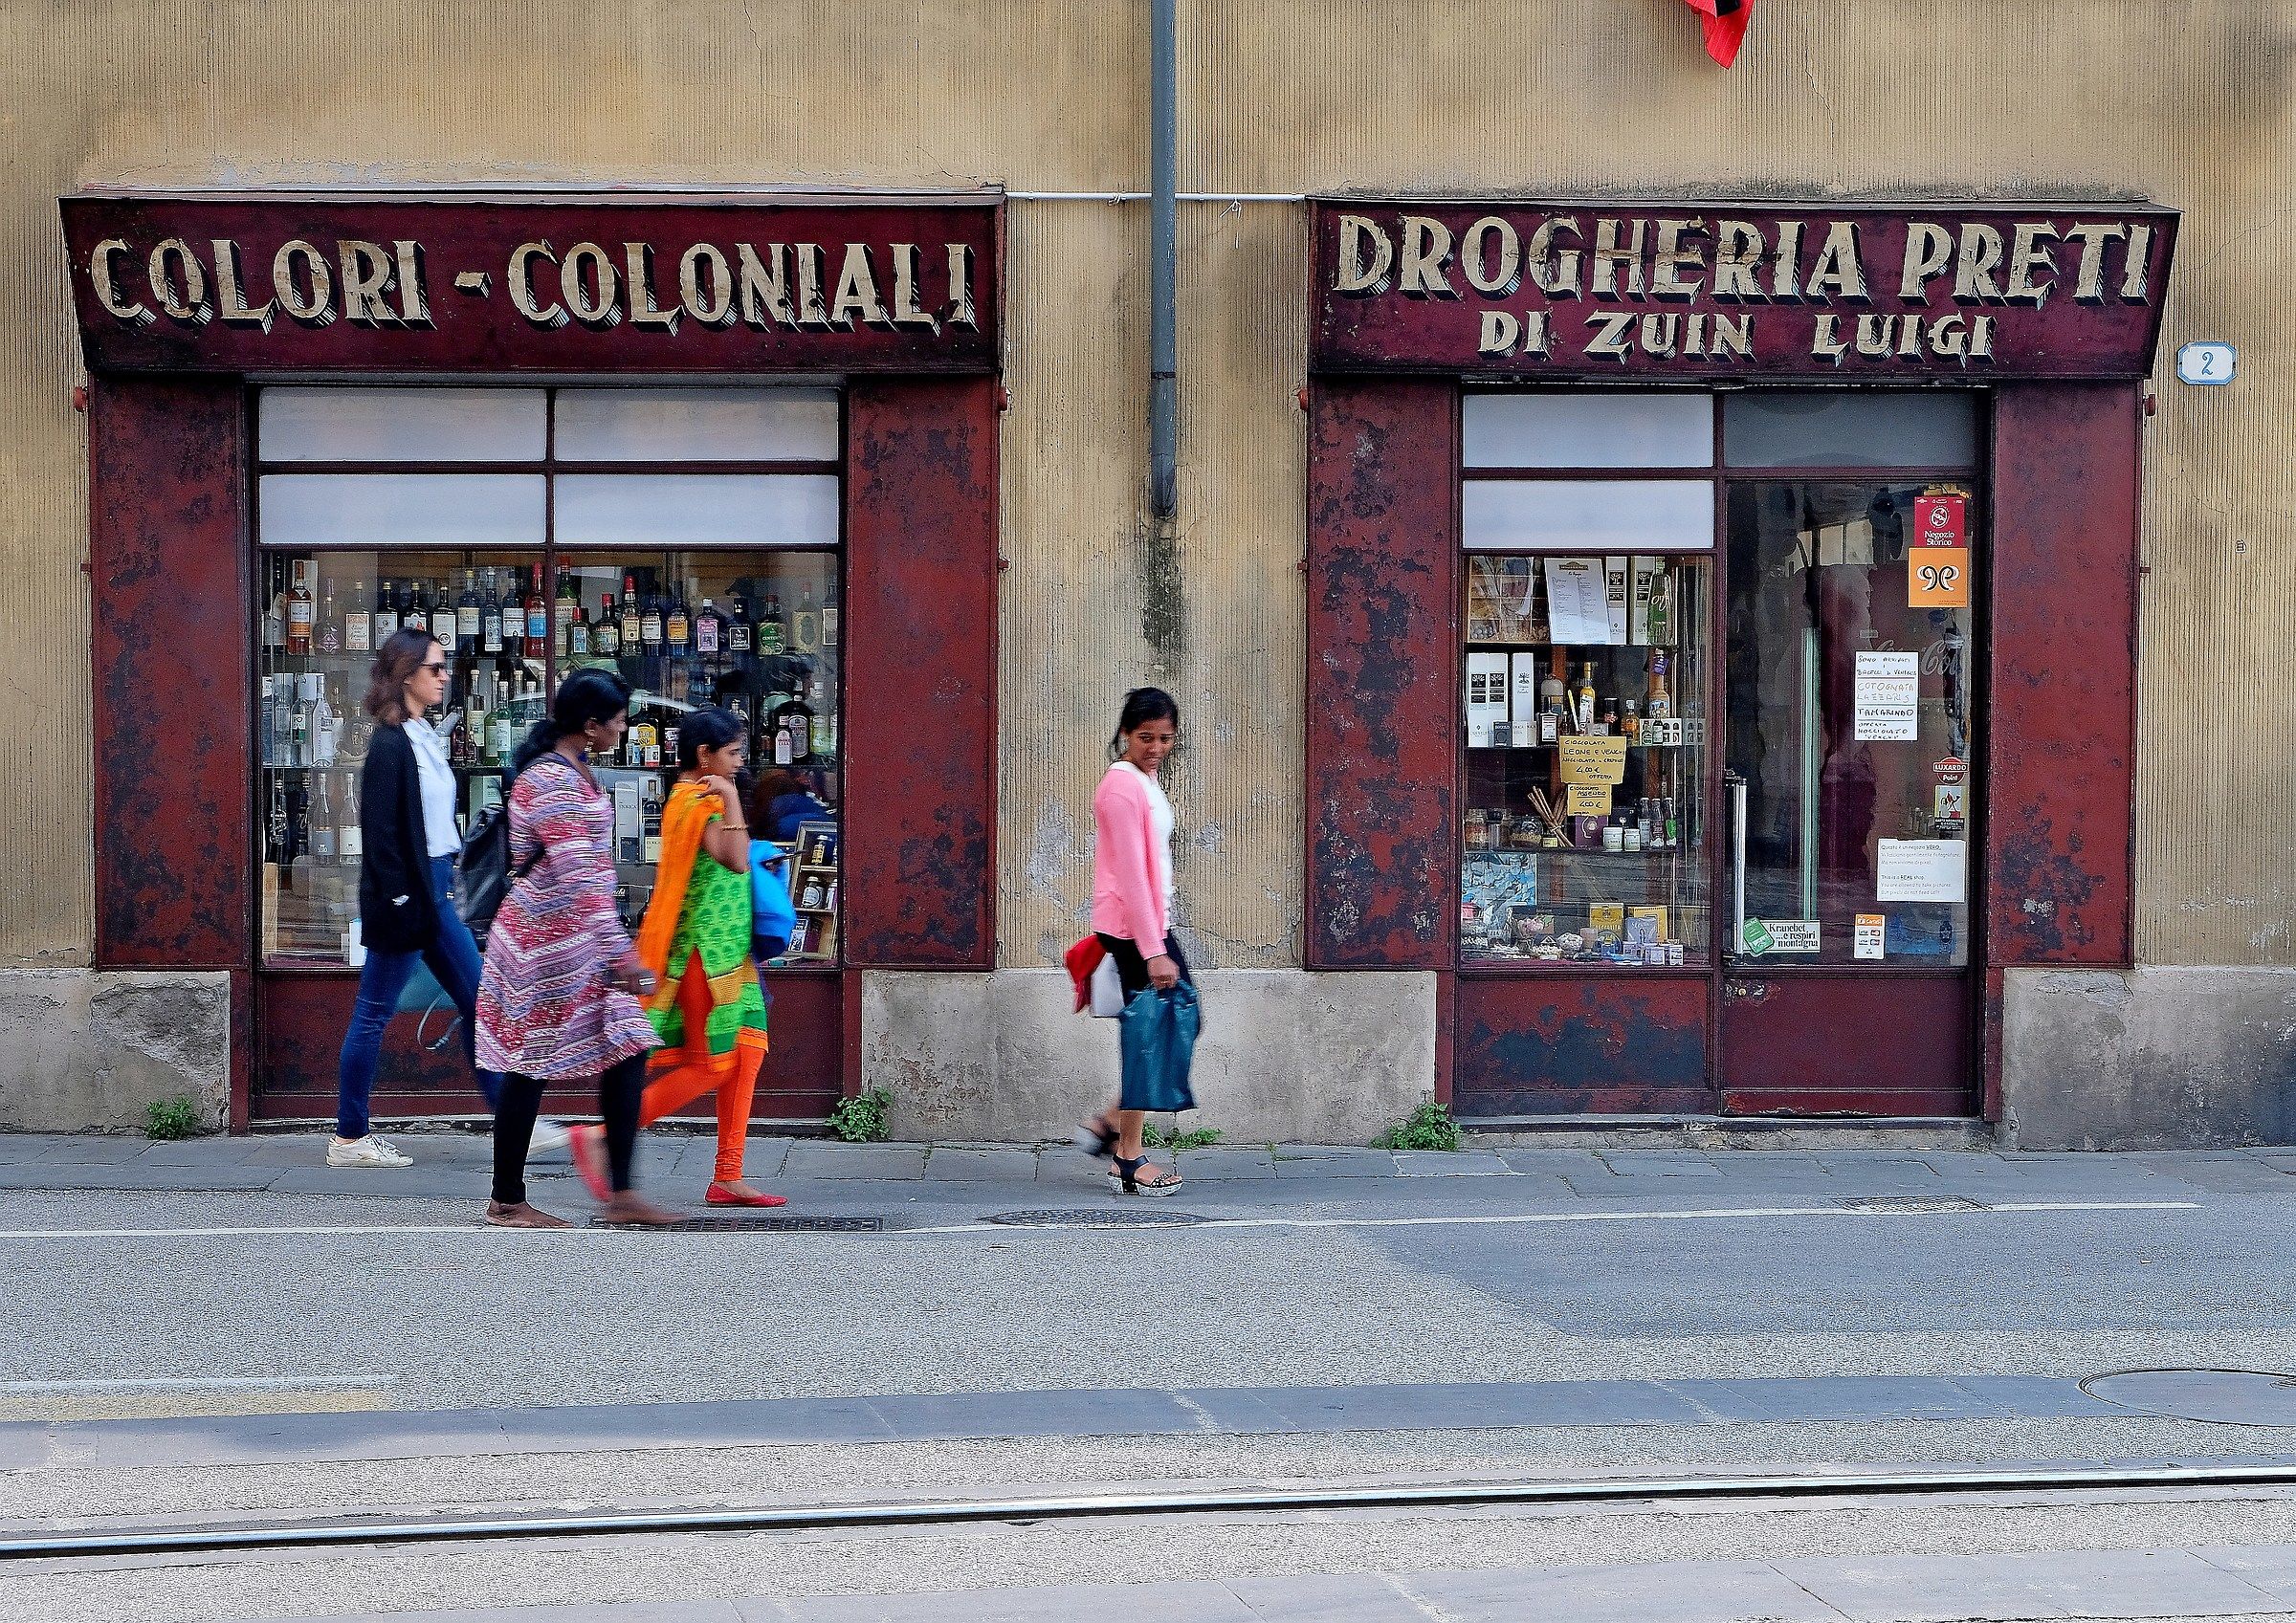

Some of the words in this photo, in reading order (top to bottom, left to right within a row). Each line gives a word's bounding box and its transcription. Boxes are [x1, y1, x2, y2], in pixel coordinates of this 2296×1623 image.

[1336, 215, 1873, 306] DROGHERIA
[1898, 221, 2155, 307] PRETI
[90, 237, 436, 333] COLORI
[507, 237, 980, 336] COLONIALI
[1478, 309, 1550, 360] DI
[1583, 310, 1756, 364] ZUIN
[1814, 312, 1997, 365] LUIGI
[2201, 351, 2214, 376] 2
[1924, 530, 1955, 540] Negozio
[1926, 537, 1954, 546] Storico
[1857, 708, 1914, 717] TAMARINDO
[1563, 747, 1591, 756] LEONE
[1768, 923, 1806, 932] Kranebet
[1789, 931, 1816, 941] respiri
[1777, 940, 1819, 949] montagna
